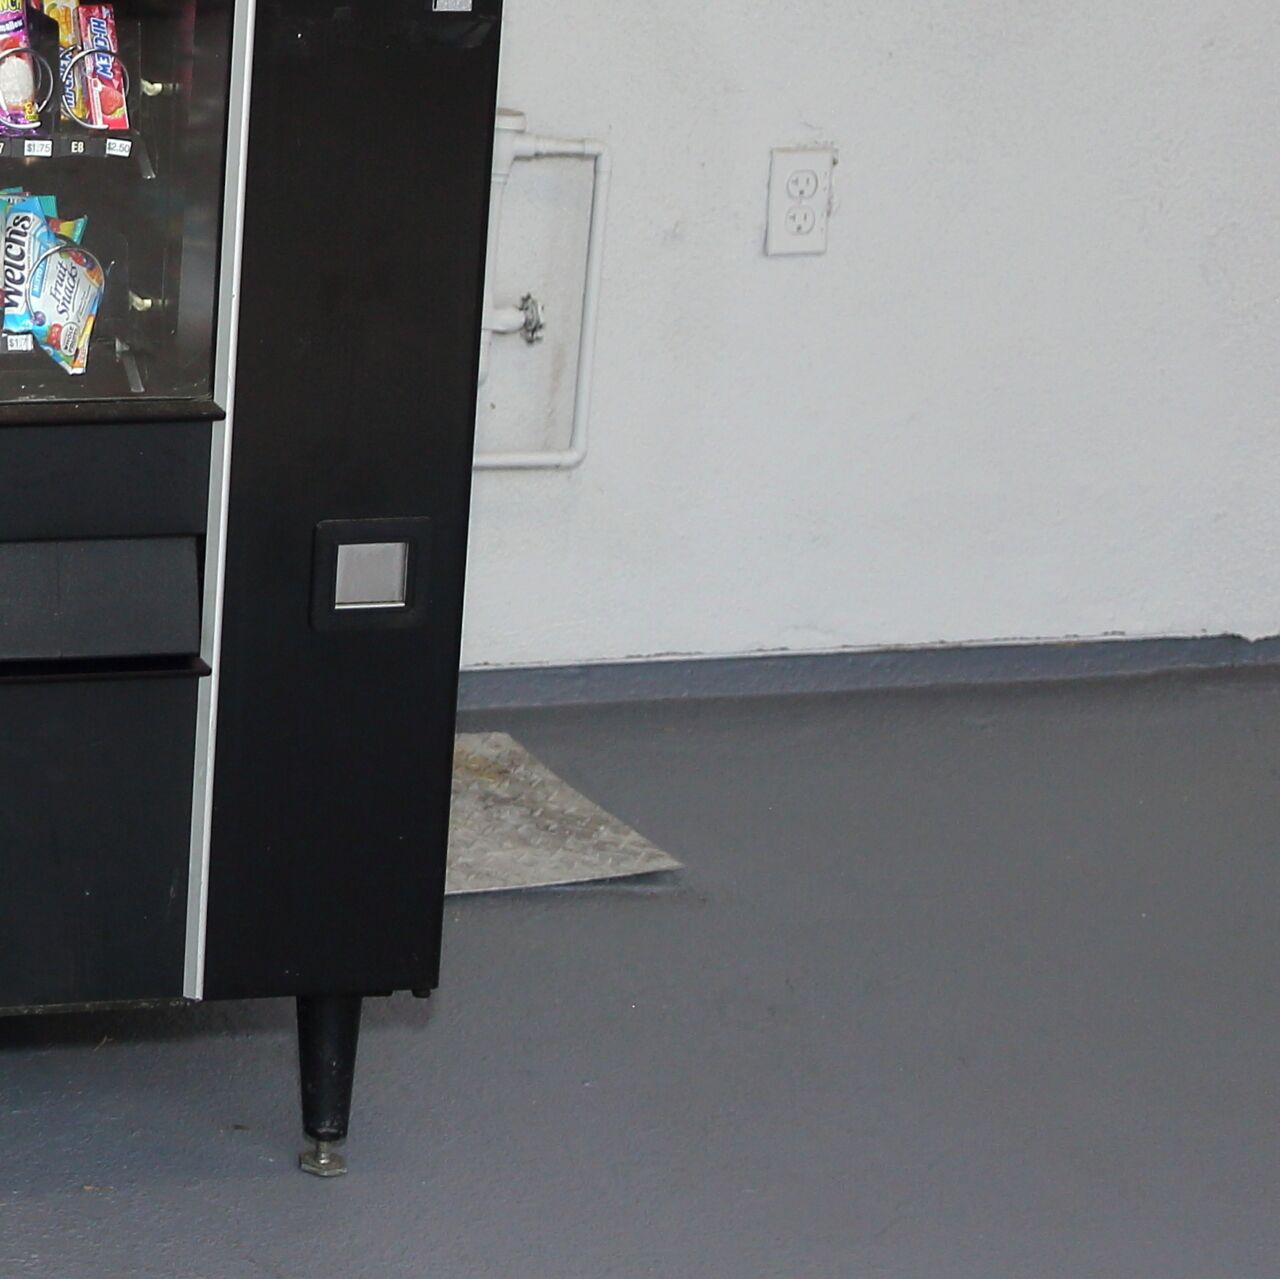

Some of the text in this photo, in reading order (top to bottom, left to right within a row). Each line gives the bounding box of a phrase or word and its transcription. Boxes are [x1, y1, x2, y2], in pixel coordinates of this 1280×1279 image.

[27, 143, 51, 153] $1.75
[71, 142, 84, 153] E8
[107, 141, 130, 152] $2.50
[50, 259, 68, 302] Fruit
[55, 265, 79, 320] Snacks
